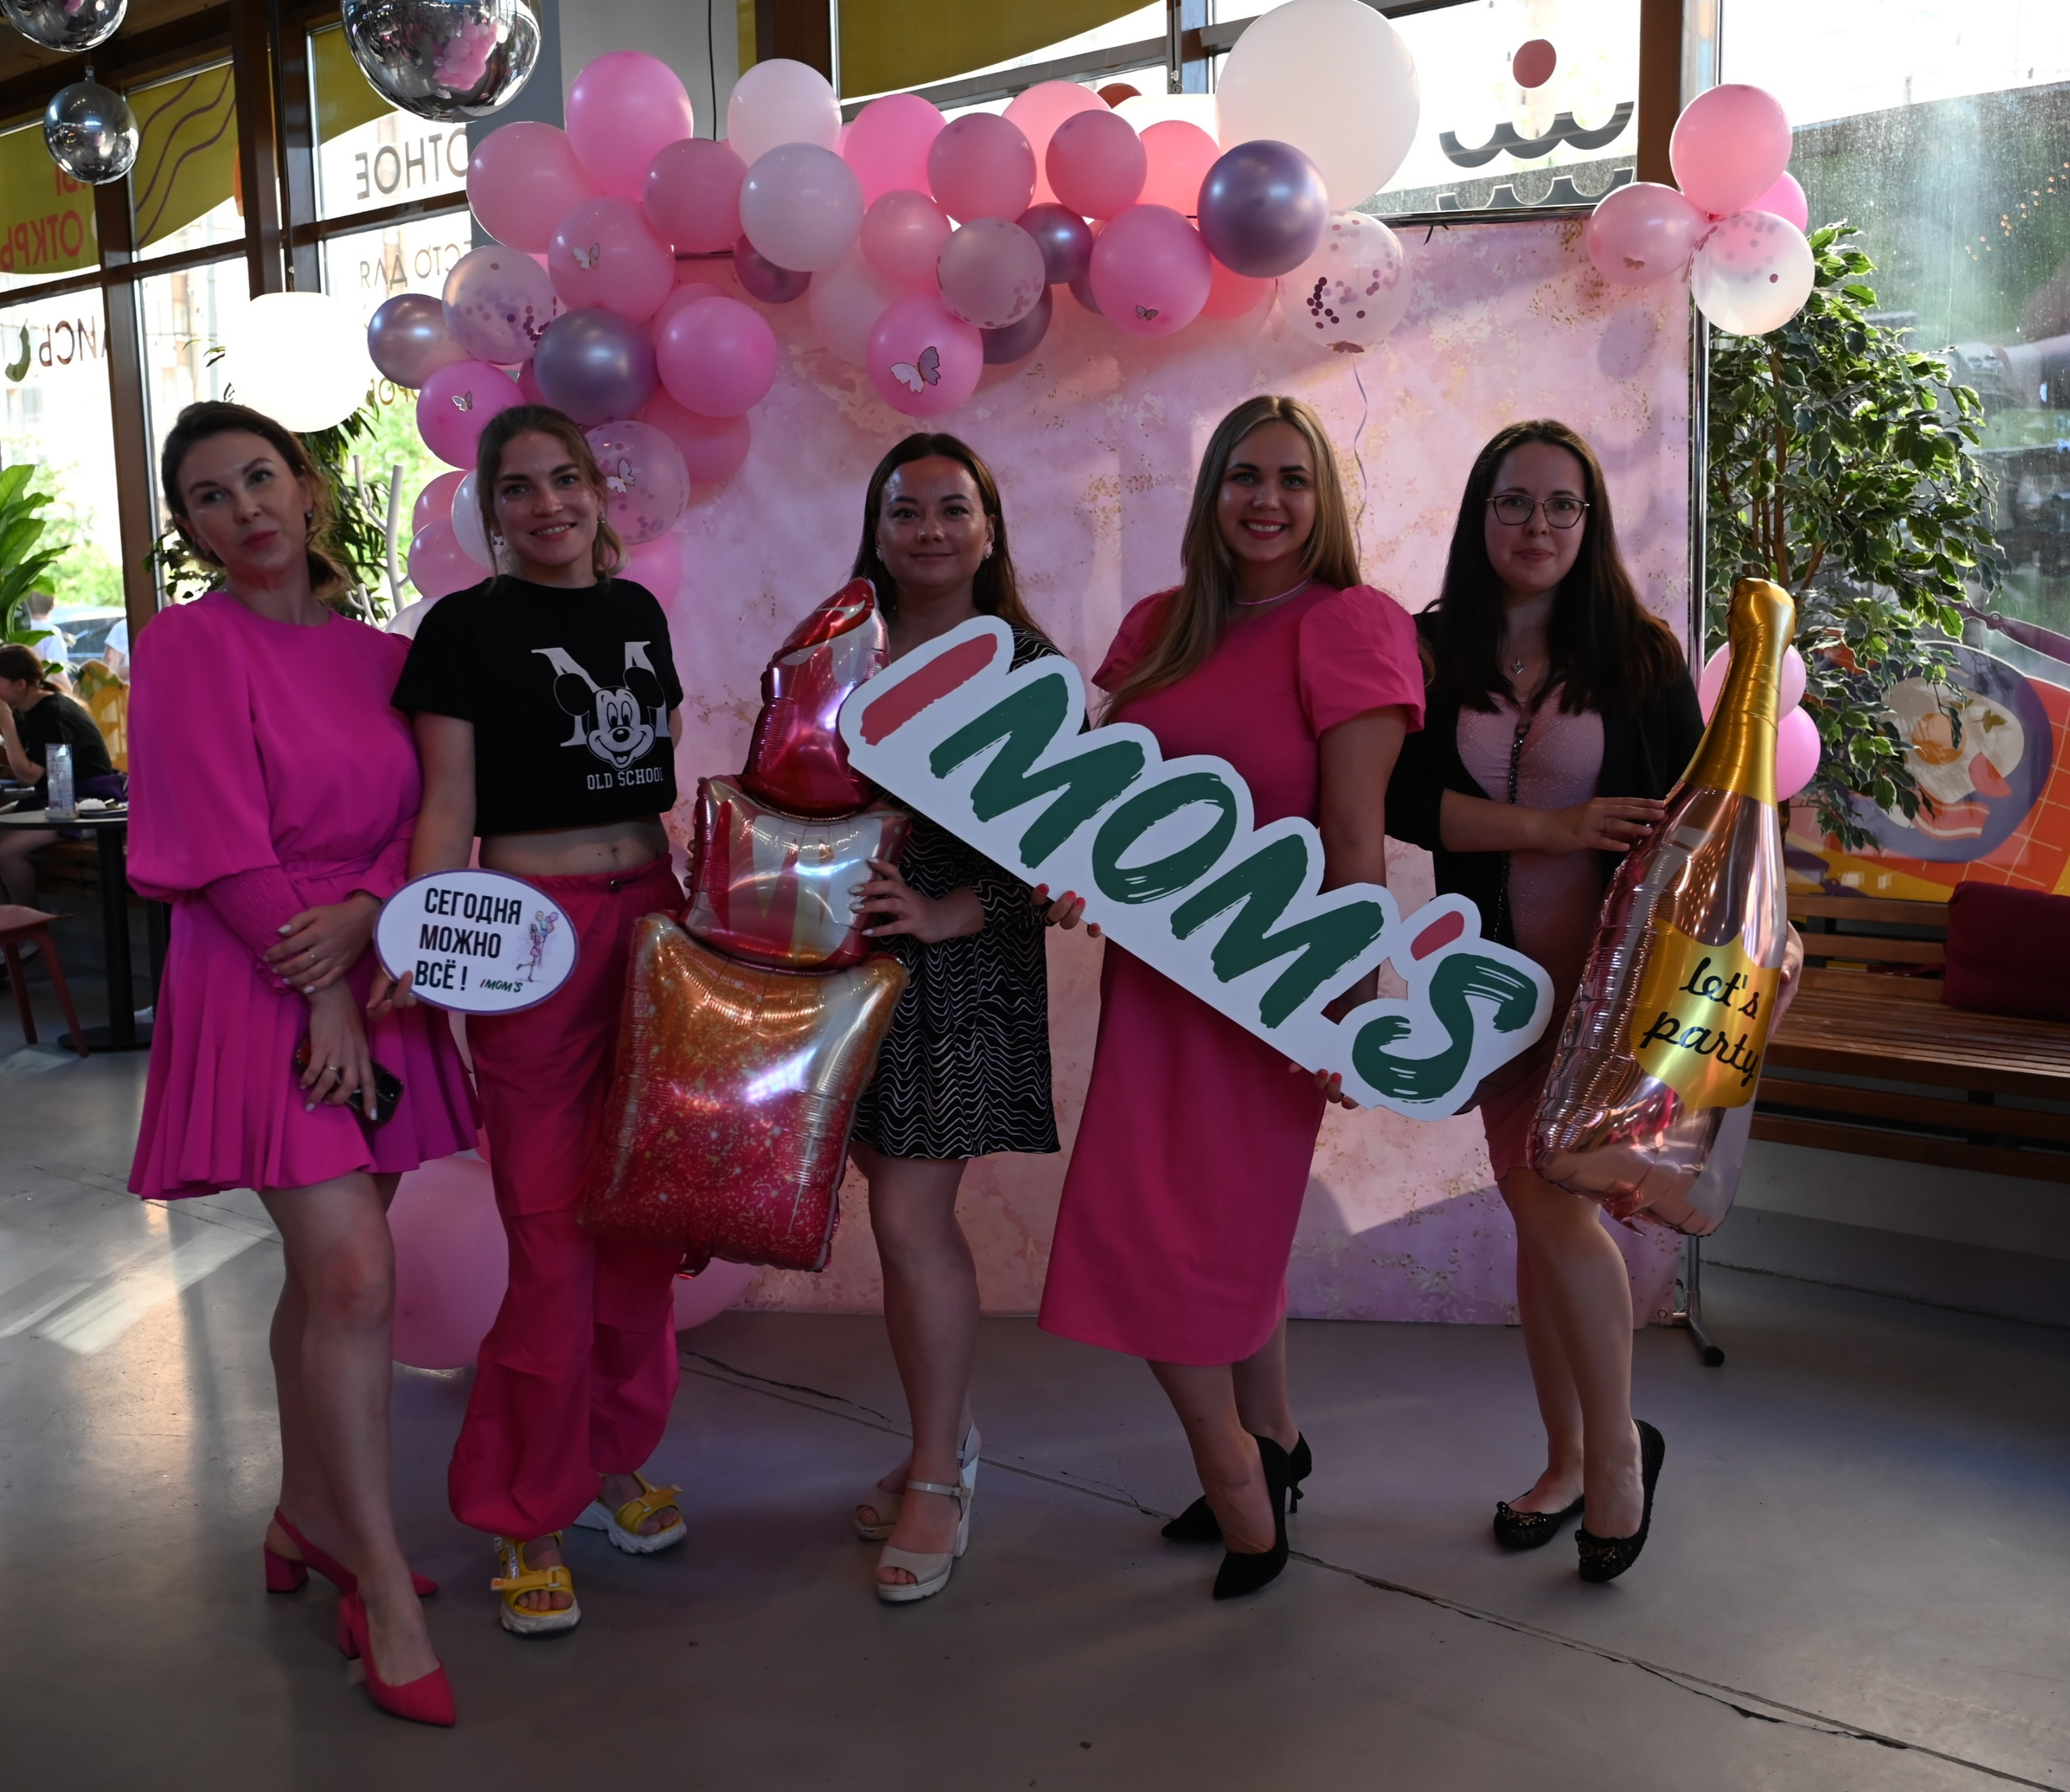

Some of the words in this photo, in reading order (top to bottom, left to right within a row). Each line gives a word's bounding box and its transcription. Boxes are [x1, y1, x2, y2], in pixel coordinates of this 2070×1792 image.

[586, 773, 613, 790] OLD
[424, 887, 522, 925] СЕГОДНЯ
[419, 923, 501, 959] МОЖНО
[1679, 957, 1760, 1020] let's
[1639, 1011, 1760, 1087] party
